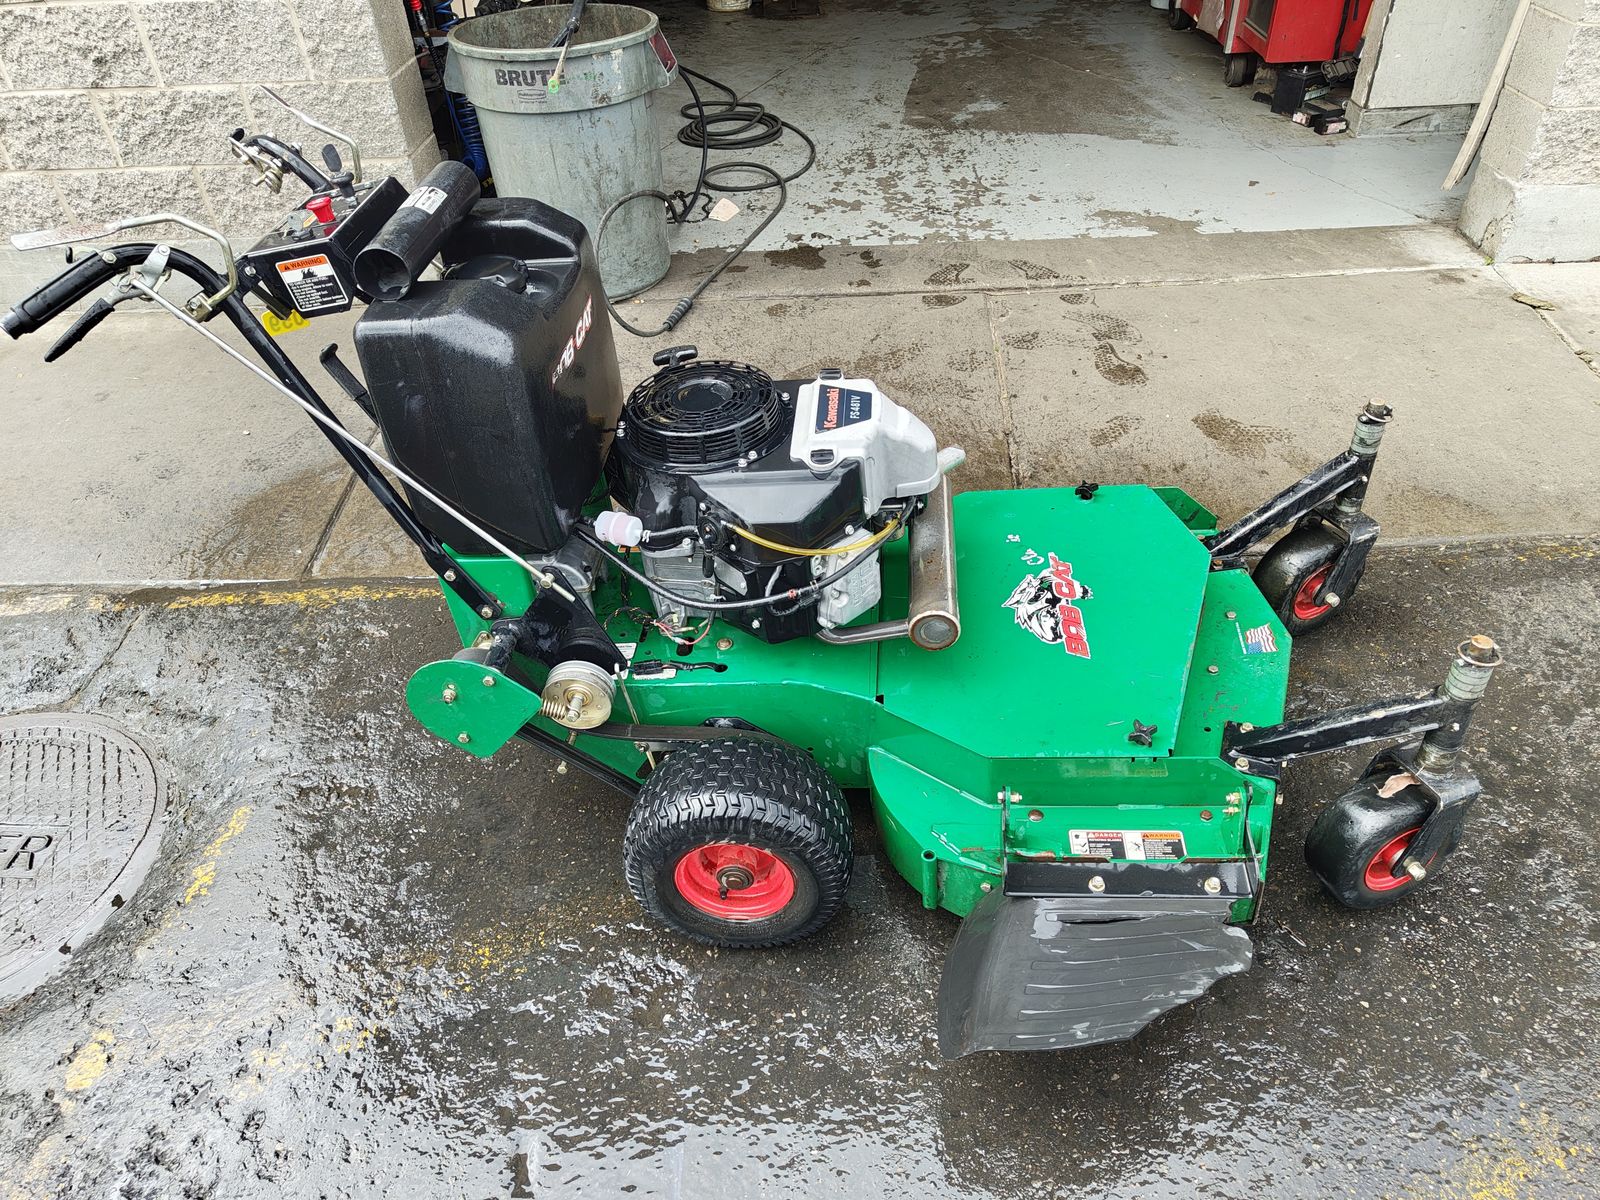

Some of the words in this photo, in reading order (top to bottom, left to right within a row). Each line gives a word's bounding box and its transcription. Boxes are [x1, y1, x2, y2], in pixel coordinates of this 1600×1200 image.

[290, 258, 322, 268] WARNING
[823, 388, 840, 429] Kawasaki
[850, 395, 861, 419] FS481V
[1048, 553, 1077, 599] CAT
[1058, 604, 1091, 659] BOB
